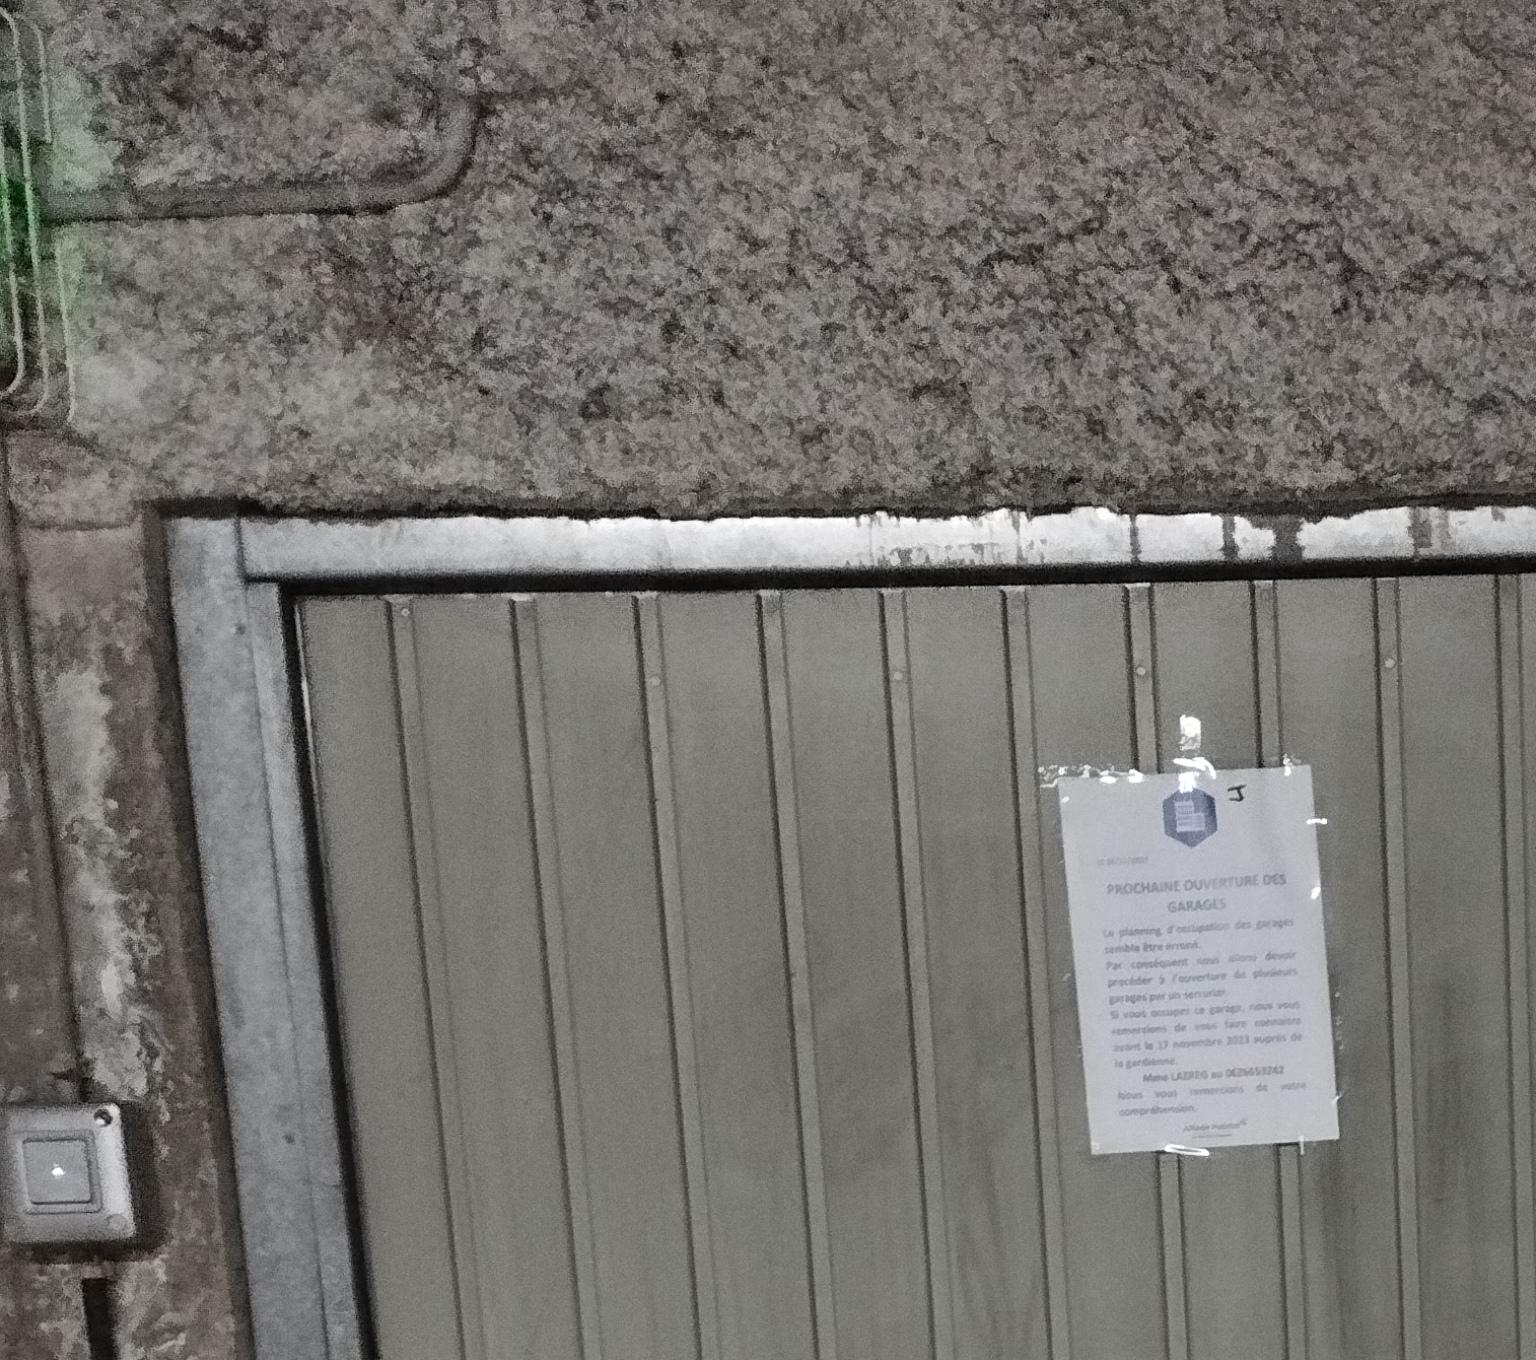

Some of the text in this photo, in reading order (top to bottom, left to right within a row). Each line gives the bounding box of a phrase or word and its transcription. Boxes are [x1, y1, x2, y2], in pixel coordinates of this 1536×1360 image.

[1107, 873, 1287, 895] PROCHAINE OUVERTURE DES
[1168, 899, 1226, 913] GARAGES
[1119, 926, 1162, 938] planning
[1234, 920, 1251, 929] des
[1256, 919, 1294, 930] garages
[1104, 943, 1139, 954] semble
[1106, 961, 1121, 970] Par
[1265, 951, 1296, 960] devoir
[1253, 967, 1298, 979] plusieurs
[1109, 994, 1147, 1005] garages
[1149, 994, 1165, 1002] par
